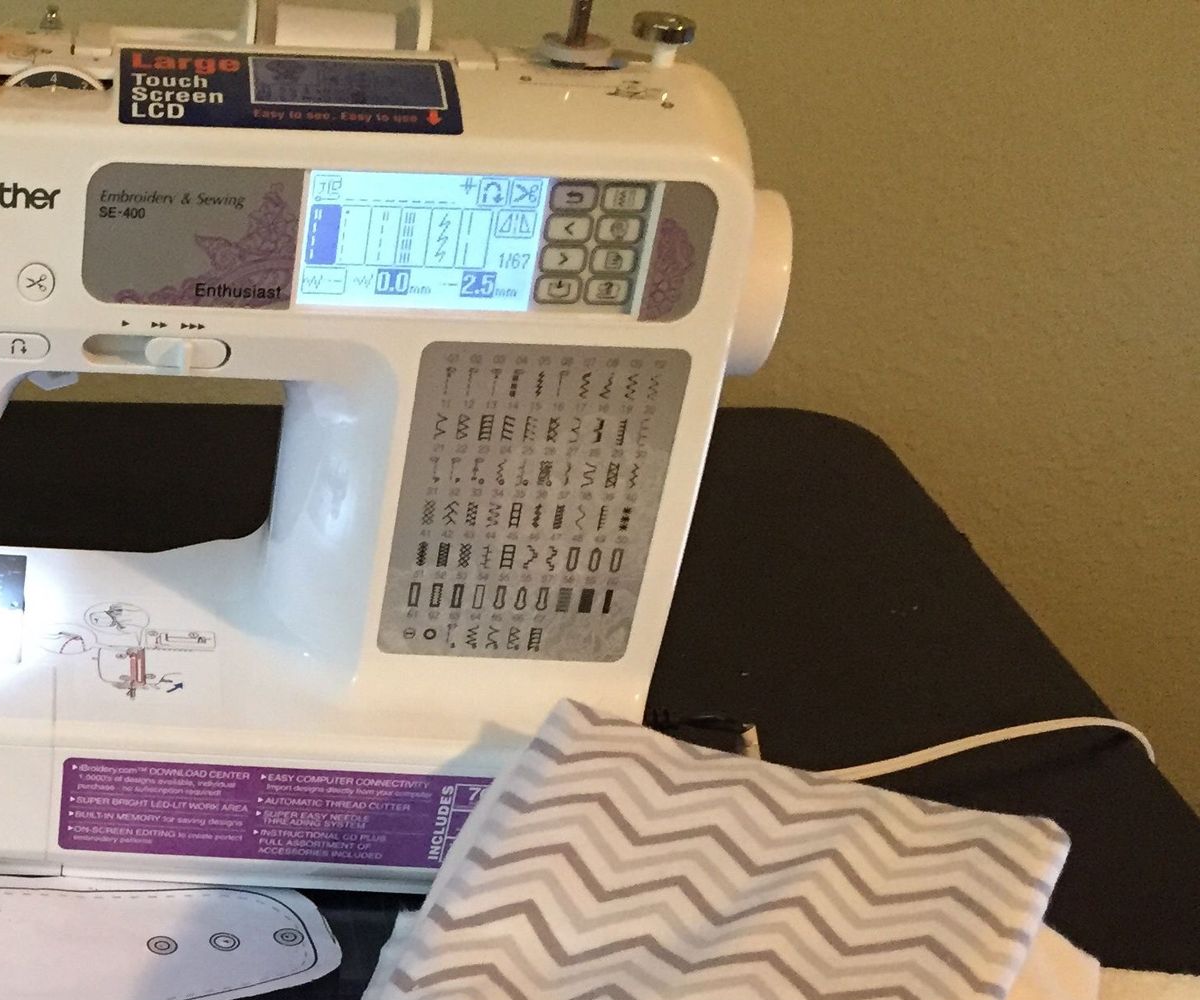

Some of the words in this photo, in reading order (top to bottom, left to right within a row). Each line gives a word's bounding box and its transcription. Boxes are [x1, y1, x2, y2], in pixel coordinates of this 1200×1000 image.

[131, 52, 241, 75] Large
[131, 73, 208, 89] Touch
[131, 87, 224, 104] Screen
[131, 102, 186, 120] LCD
[254, 109, 285, 121] Easy
[290, 110, 302, 120] to
[341, 112, 372, 123] Easy
[393, 114, 417, 123] use
[197, 192, 246, 209] Sewing
[99, 206, 146, 219] SE-400
[499, 253, 531, 270] 1/67
[195, 283, 281, 299] Enthusiast
[149, 768, 207, 778] DOWNLOAD
[208, 771, 250, 780] CENTER
[268, 774, 295, 782] EASY
[296, 775, 354, 786] COMPUTER
[355, 778, 430, 789] CONNECTIVITY
[76, 797, 110, 805] SUPER
[112, 798, 149, 807] BRIGHT
[189, 802, 219, 811] WORK
[221, 804, 248, 813] AREA
[264, 797, 323, 807] AUTOMATIC
[325, 800, 367, 809] THREAD
[368, 802, 411, 811] CUTTER
[74, 811, 114, 820] BUILT-IN
[116, 812, 161, 822] MEMORY
[208, 818, 243, 828] designs
[262, 810, 298, 818] SUPER
[300, 812, 328, 820] EASY
[428, 785, 454, 860] INCLUDES
[73, 826, 133, 836] ON-SCREEN
[135, 829, 176, 838] EDITING
[260, 830, 339, 840] INSTRUCTIONAL
[360, 834, 387, 842] PLUS
[287, 839, 354, 850] ASSORTMENT
[258, 847, 329, 857] ACCESSORIES
[331, 850, 383, 860] INCLUDED
